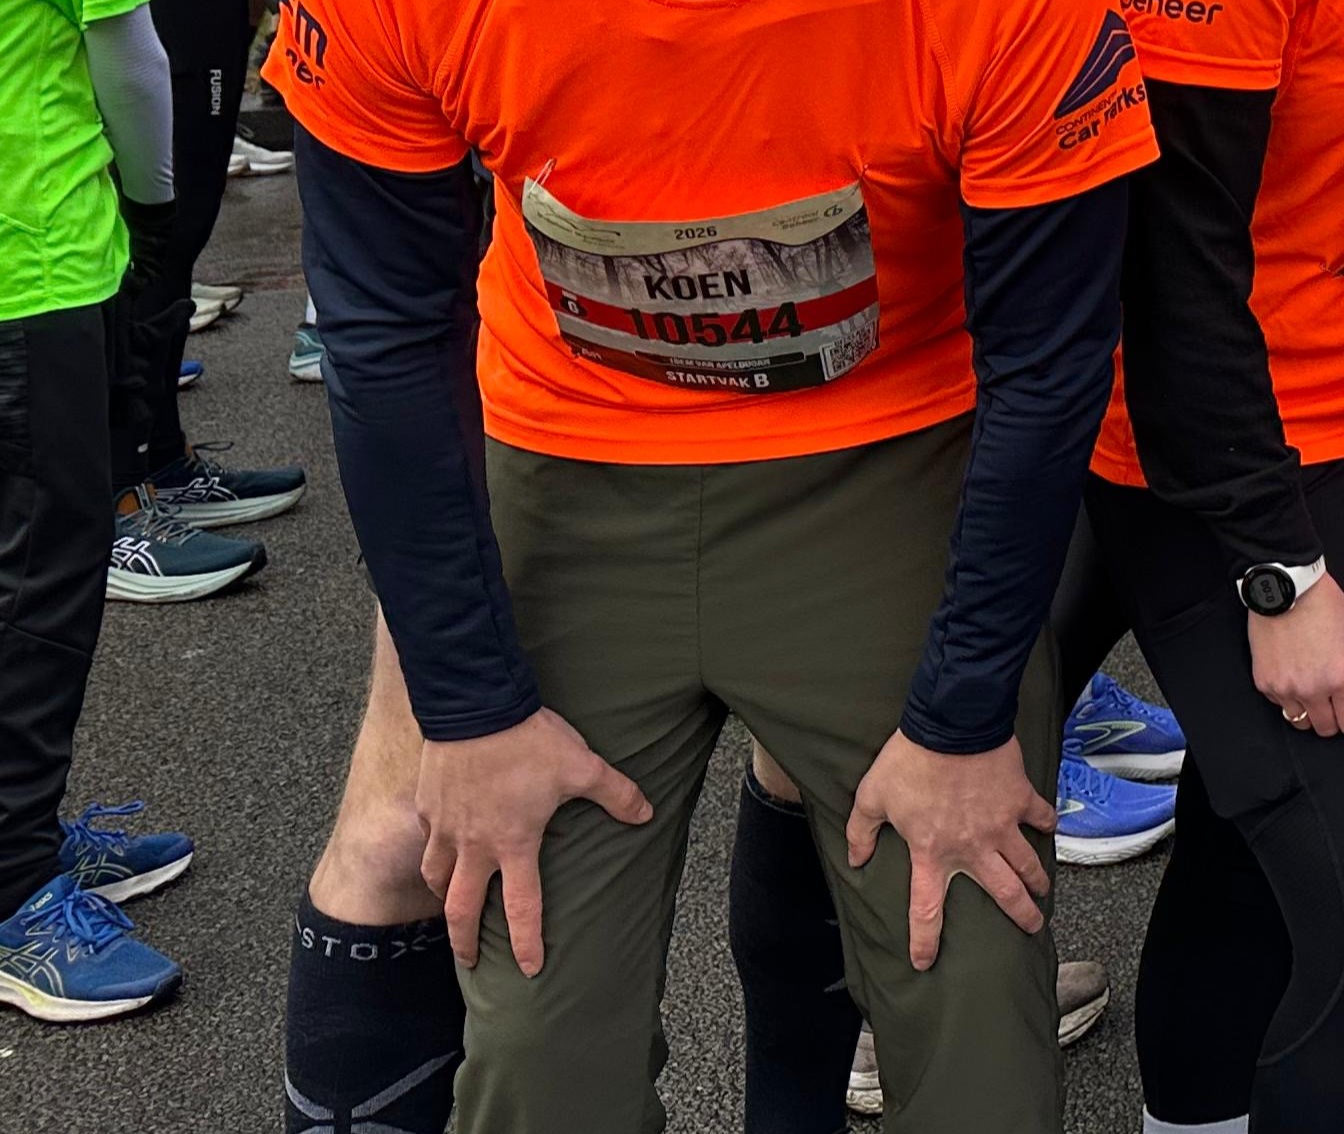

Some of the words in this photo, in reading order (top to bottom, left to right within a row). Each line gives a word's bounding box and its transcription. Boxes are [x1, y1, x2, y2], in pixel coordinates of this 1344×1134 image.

[210, 69, 222, 116] FUSION
[1058, 119, 1101, 151] Car
[674, 225, 718, 242] 2026
[643, 268, 753, 302] KOEN
[624, 300, 805, 348] 10544
[665, 369, 751, 389] STARTVAK
[753, 372, 771, 389] B
